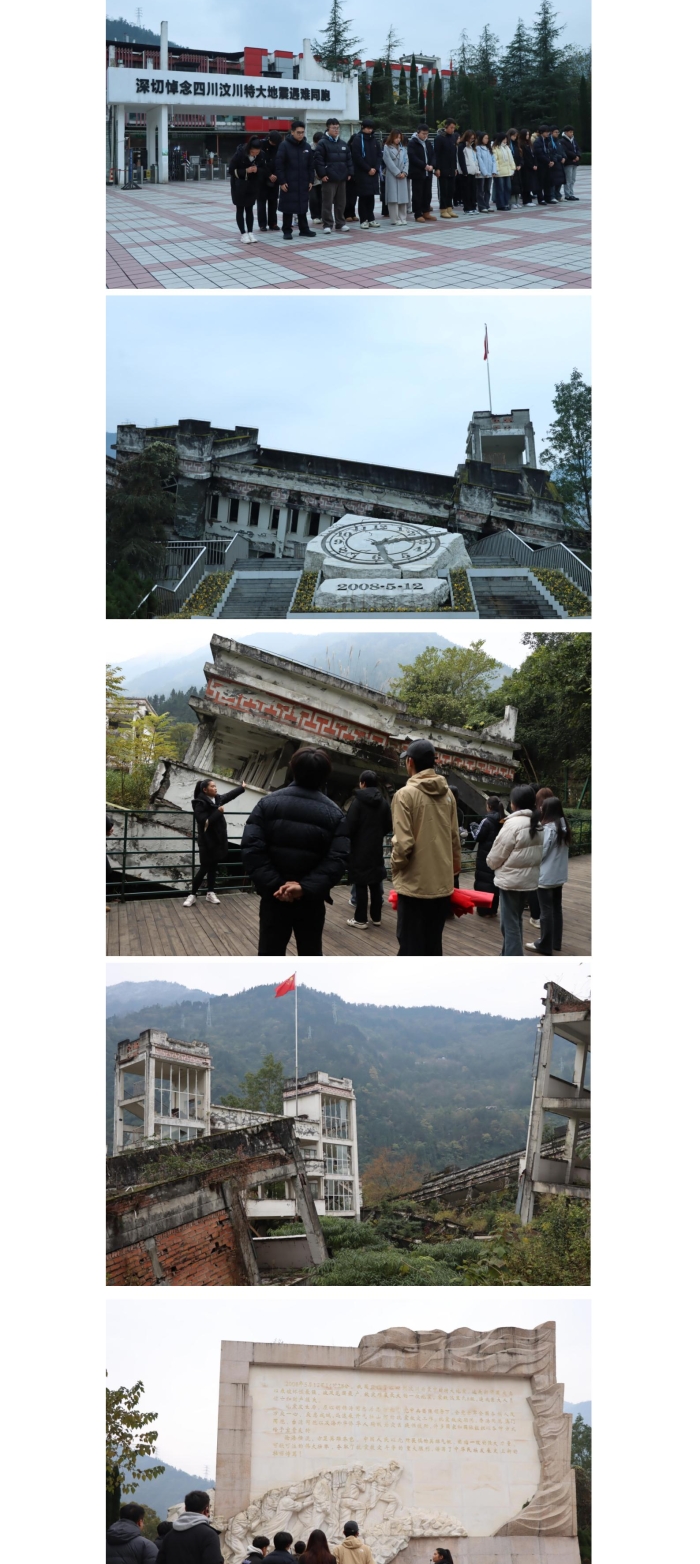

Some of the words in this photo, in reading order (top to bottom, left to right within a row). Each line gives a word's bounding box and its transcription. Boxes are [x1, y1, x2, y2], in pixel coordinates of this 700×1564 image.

[135, 78, 331, 102] 深切悼念四川汶川特大地震遇难同胞
